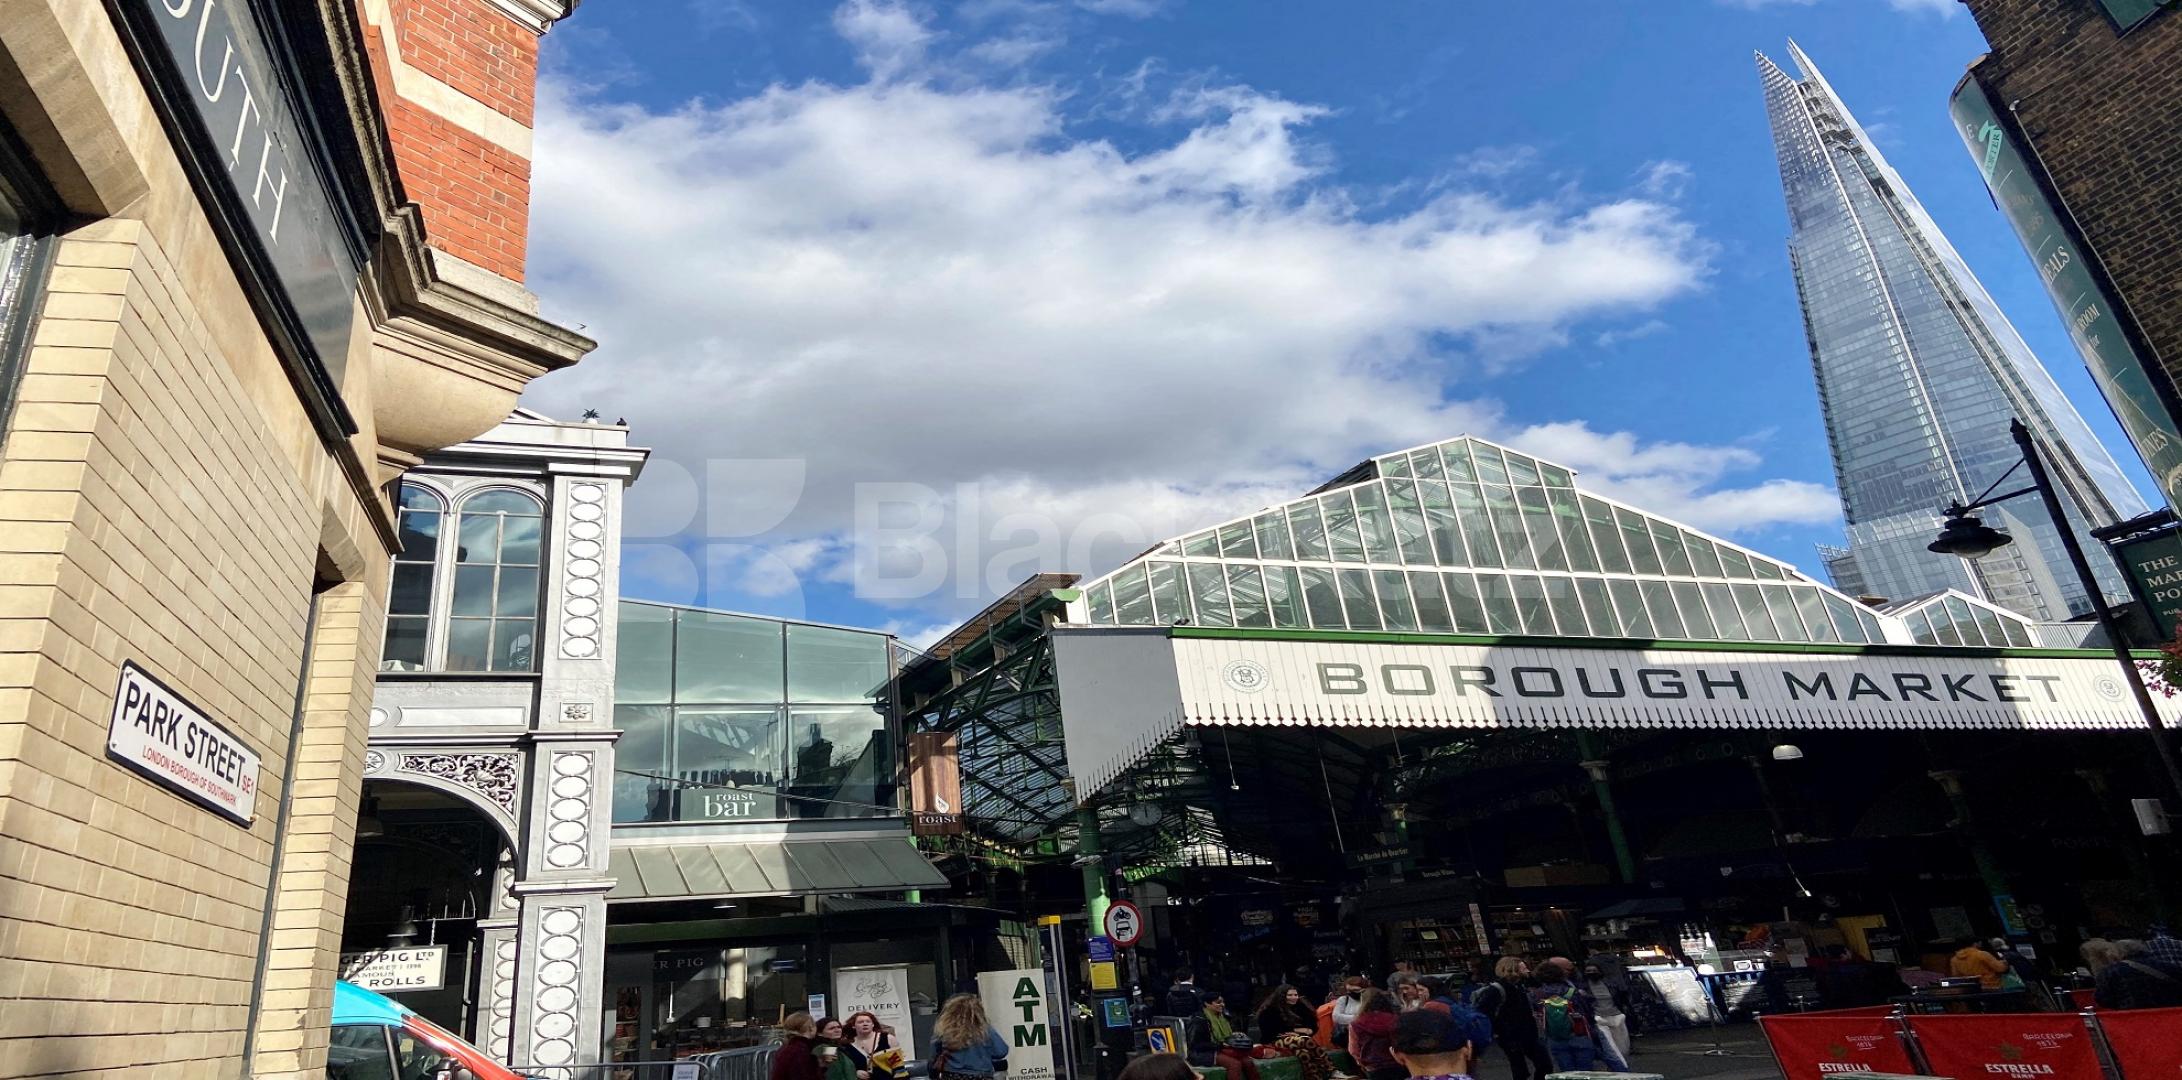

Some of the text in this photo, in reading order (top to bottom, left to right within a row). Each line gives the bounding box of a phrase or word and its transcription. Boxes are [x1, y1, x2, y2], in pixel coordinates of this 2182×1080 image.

[161, 0, 288, 246] UTH
[2137, 555, 2179, 573] THE
[2154, 586, 2182, 603] PO
[1315, 662, 1749, 700] BOROUGH
[1781, 670, 2061, 703] MARKET
[122, 680, 255, 797] PARK STREET SE1
[142, 745, 238, 807] LONDON BOROUGH OF SOUTHWARK
[716, 793, 754, 801] roast
[703, 795, 757, 817] bar
[919, 815, 958, 824] roast
[379, 953, 409, 963] PIG
[677, 957, 704, 969] PIG
[369, 976, 426, 987] ROLLS
[848, 1003, 900, 1012] DELIVERY
[1012, 977, 1047, 1047] ATM
[1020, 1066, 1048, 1075] CASH
[1818, 1062, 1872, 1072] ESTRELLA
[1984, 1063, 2055, 1074] ESTRELLA
